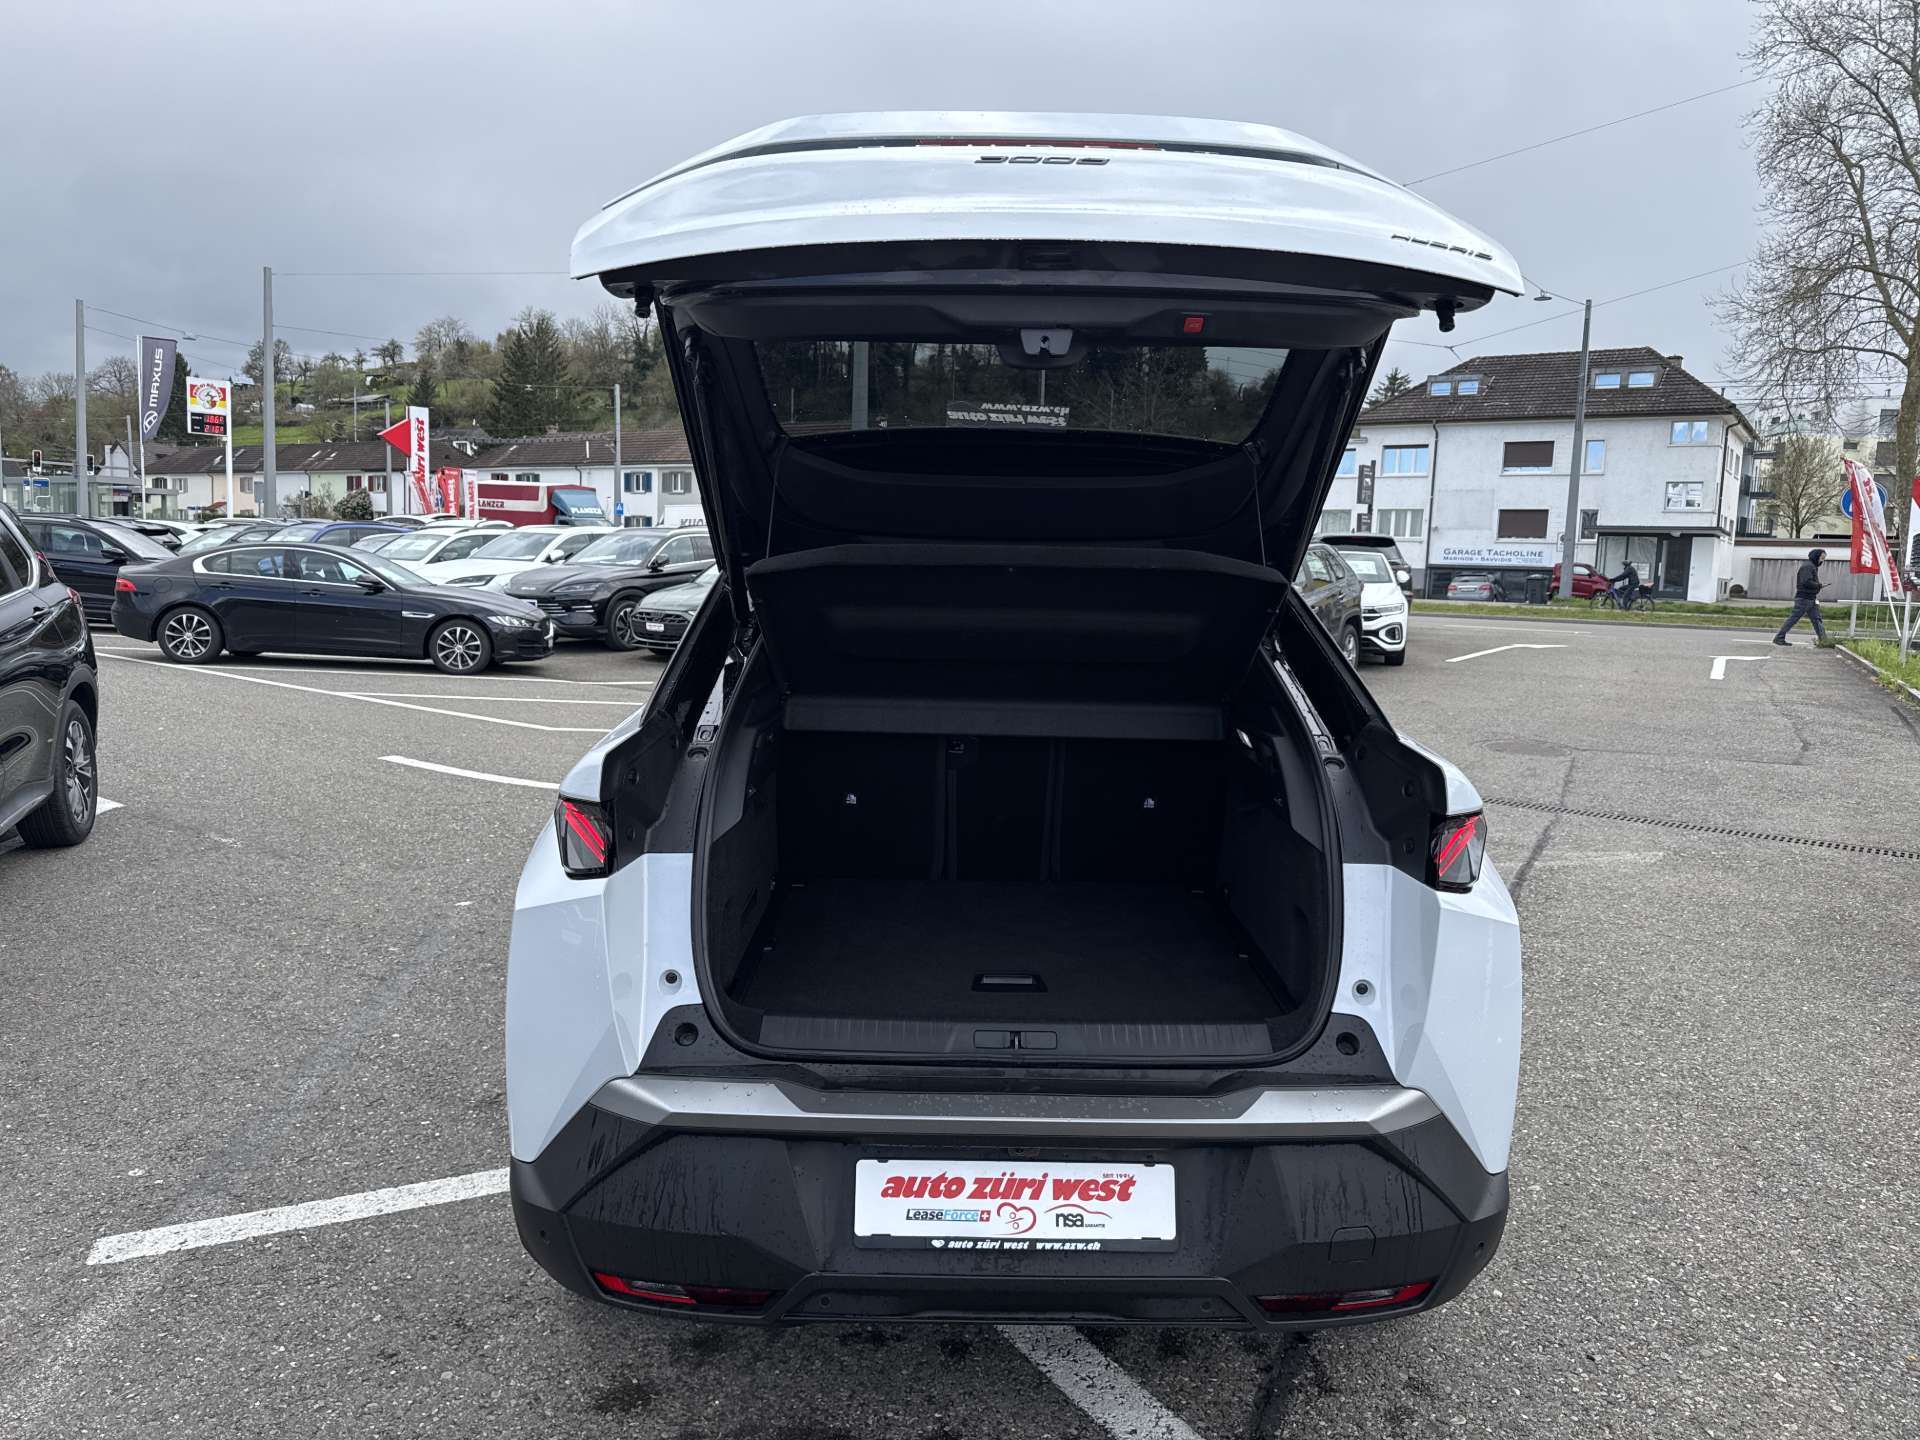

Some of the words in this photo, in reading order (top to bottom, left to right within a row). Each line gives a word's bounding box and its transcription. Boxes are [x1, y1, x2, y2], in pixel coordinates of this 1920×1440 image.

[149, 347, 164, 408] MAXUS
[478, 500, 505, 508] LANZER
[1443, 548, 1483, 557] GARAGE
[1486, 549, 1544, 558] TACHOLINE
[880, 1171, 966, 1199] auto
[967, 1171, 1049, 1201] züri
[1052, 1175, 1137, 1202] west
[905, 1208, 980, 1222] LeaseForce
[1055, 1212, 1085, 1228] nsa
[947, 1240, 974, 1250] auto
[975, 1238, 1001, 1250] züri
[1003, 1240, 1029, 1250] west
[1036, 1240, 1101, 1251] www.azw.ch
